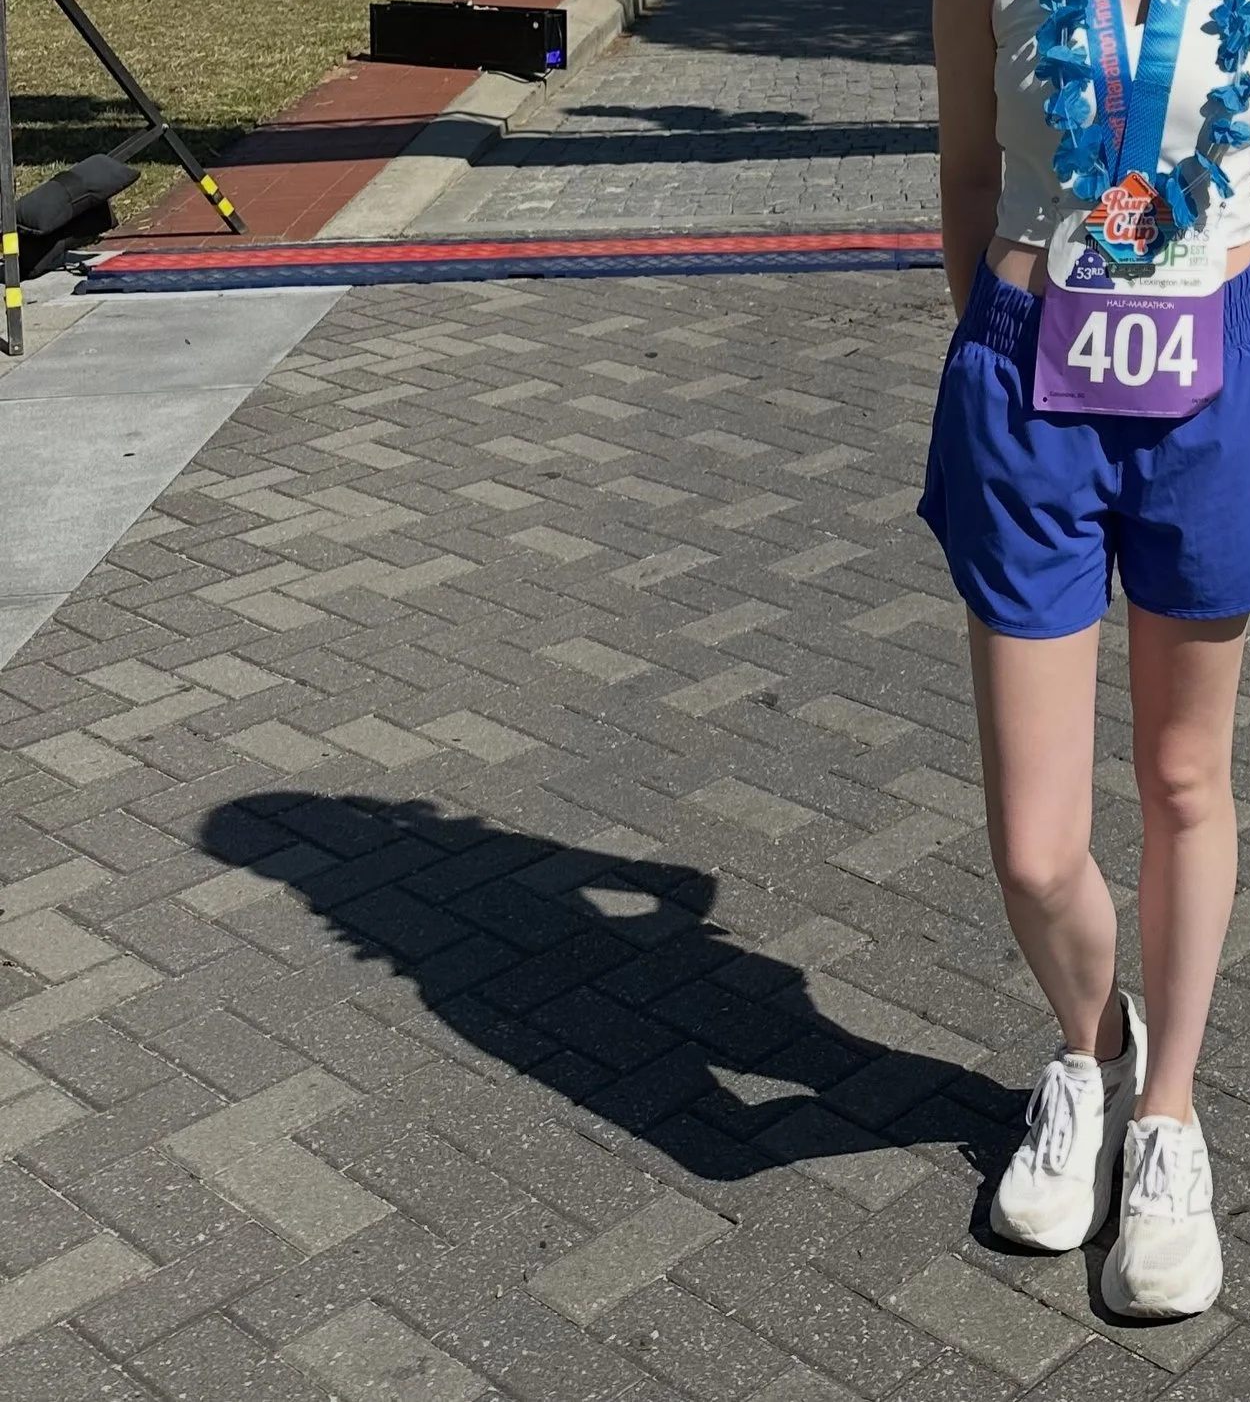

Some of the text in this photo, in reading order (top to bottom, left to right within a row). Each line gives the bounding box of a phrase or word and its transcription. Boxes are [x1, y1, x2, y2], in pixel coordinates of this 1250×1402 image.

[1102, 187, 1153, 214] Run
[1104, 211, 1158, 255] Cup
[1076, 267, 1105, 280] 53RD
[1106, 299, 1175, 310] HALF-MARATHON
[1067, 311, 1198, 387] 404
